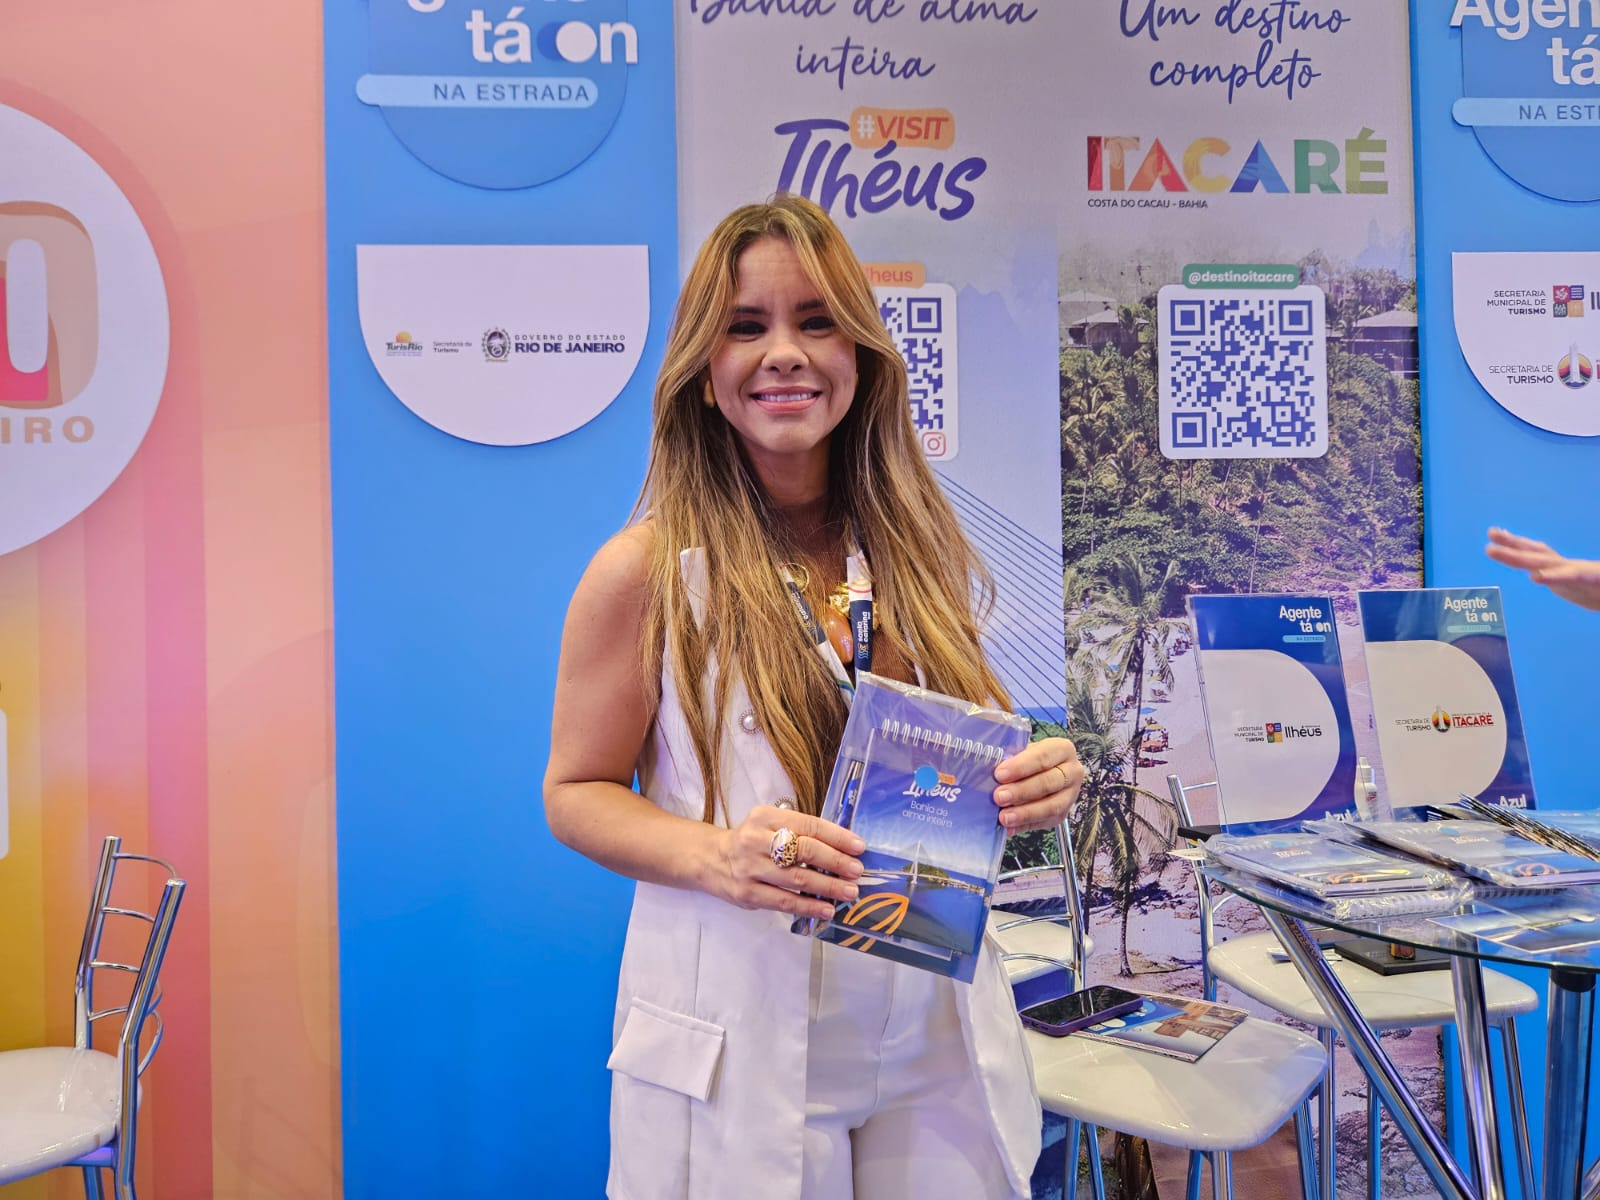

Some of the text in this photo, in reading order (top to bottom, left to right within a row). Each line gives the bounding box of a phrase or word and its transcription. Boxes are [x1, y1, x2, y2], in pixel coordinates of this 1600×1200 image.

[1119, 0, 1351, 43] Um destino
[465, 7, 532, 63] tá
[796, 37, 936, 90] inteira
[1150, 40, 1322, 104] completo
[433, 83, 590, 102] NA ESTRADA
[1519, 104, 1600, 121] NA EST
[856, 113, 949, 140] #VISIT
[1087, 126, 1389, 195] ITACARÉ
[1087, 199, 1118, 208] COSTA
[1120, 199, 1136, 208] DO
[1137, 199, 1171, 209] CACAU
[1178, 200, 1208, 209] BAHIA
[1188, 271, 1295, 285] @destinoitacare
[1493, 290, 1546, 298] SECRETARIA
[1486, 298, 1546, 307] MUNICIPAL DE
[514, 342, 625, 353] RIO DE JANEIRO
[1488, 365, 1554, 374] SECRETARIA DE
[1506, 376, 1554, 384] TURISMO
[1444, 596, 1488, 613] Agente
[1279, 605, 1322, 622] Agente
[1465, 608, 1479, 623] tá
[1452, 713, 1493, 727] ITACARÉ
[1284, 725, 1322, 738] Ilhéus
[910, 800, 935, 813] Bahia
[1499, 794, 1527, 809] Azul
